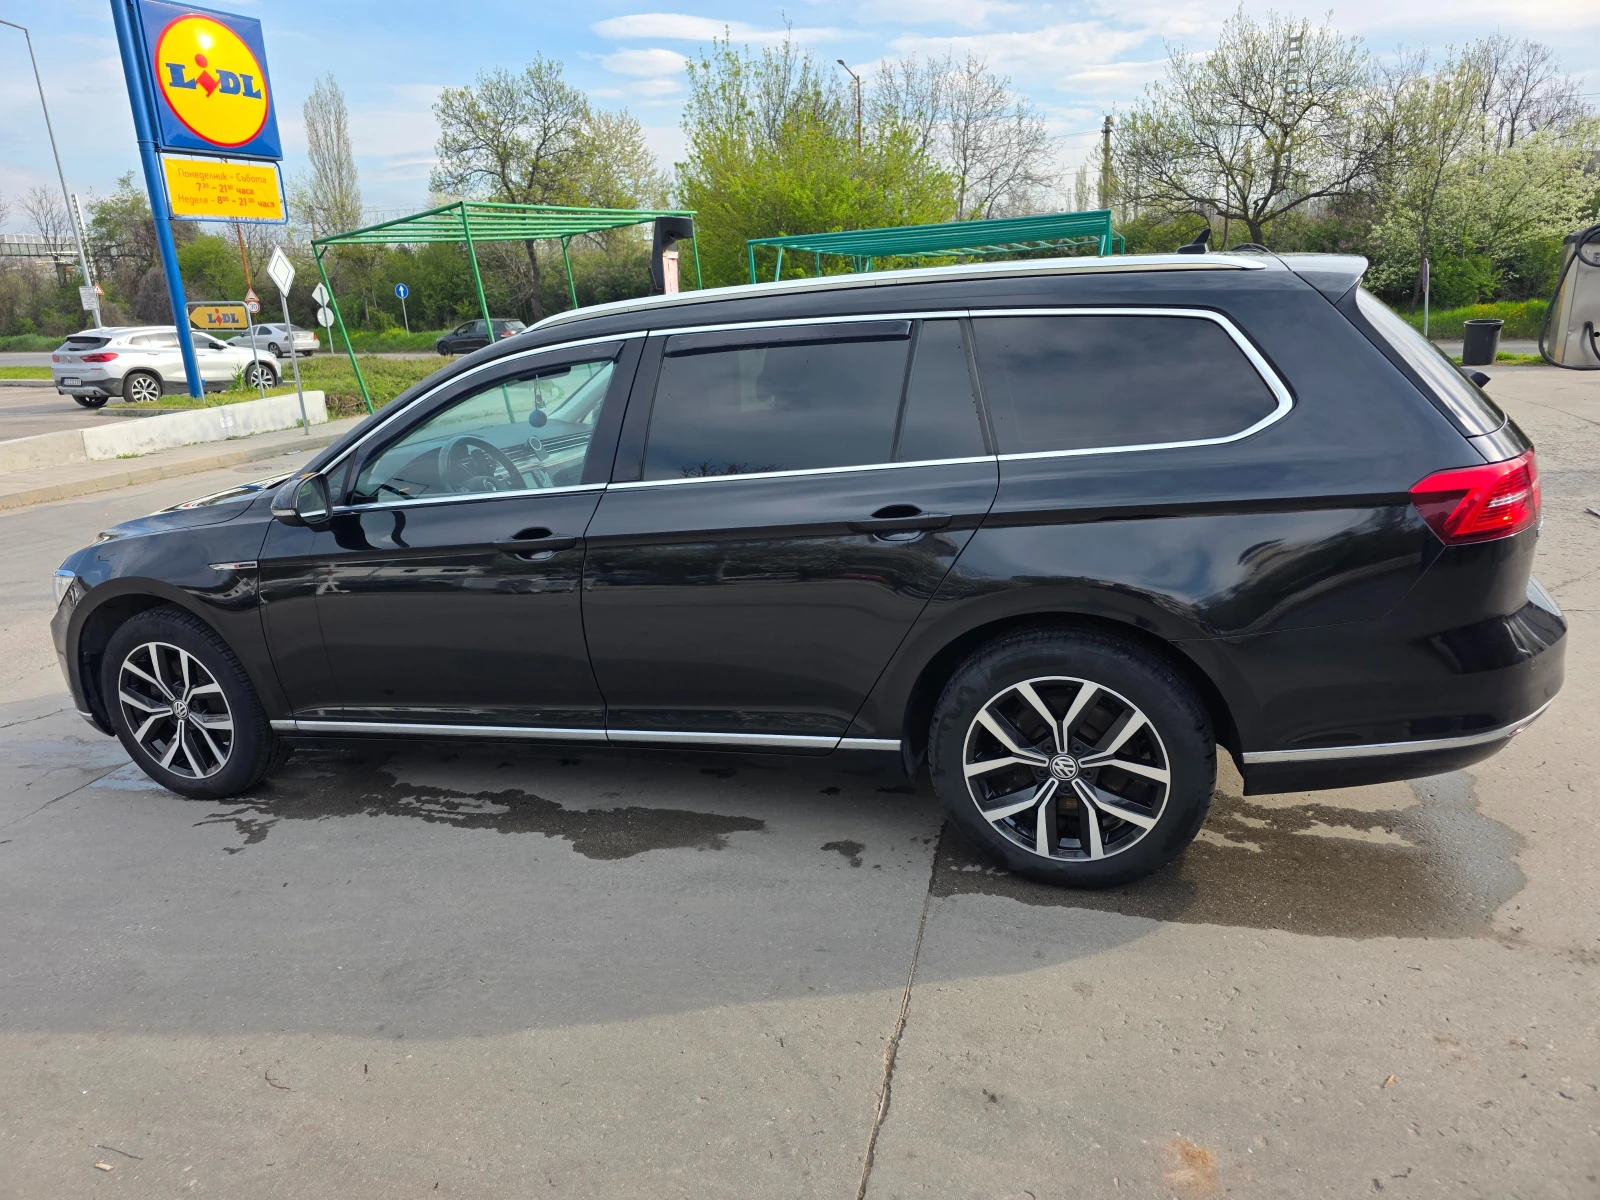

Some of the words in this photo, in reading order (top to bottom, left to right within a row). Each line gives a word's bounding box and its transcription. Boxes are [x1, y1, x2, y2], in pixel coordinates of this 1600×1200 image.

[177, 168, 227, 181] Понеделник
[236, 173, 267, 184] Събота
[236, 187, 254, 195] часа
[177, 194, 209, 206] Неделя
